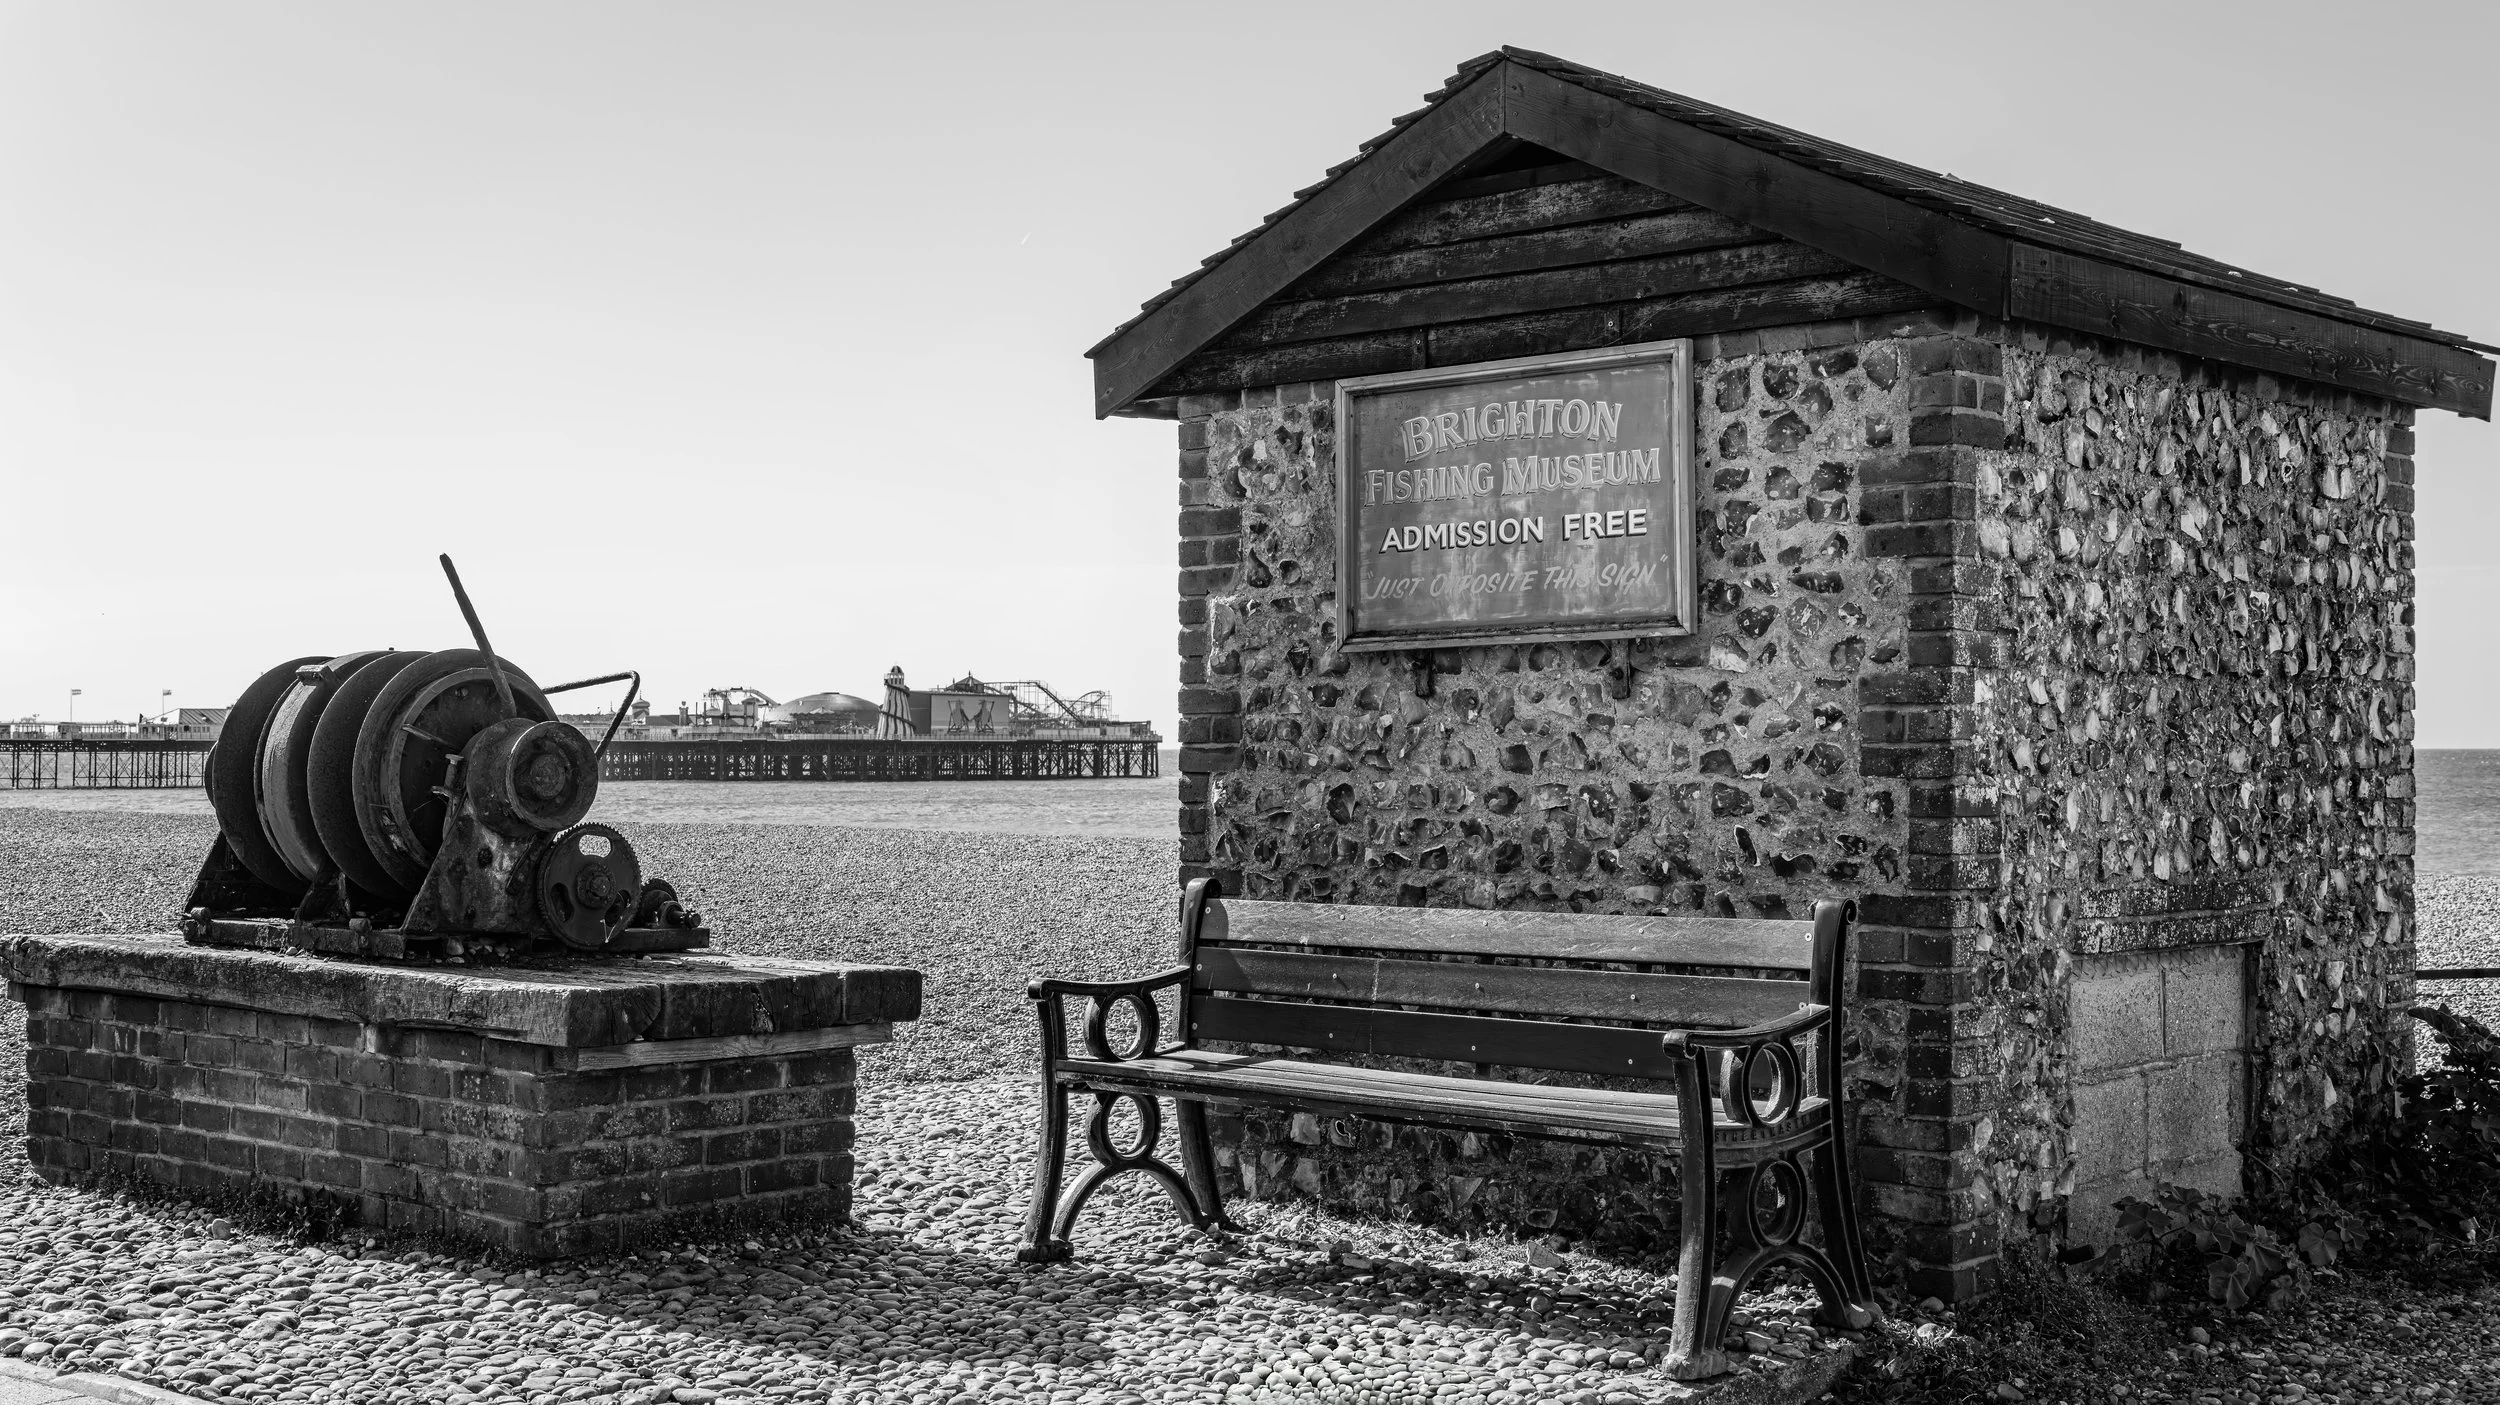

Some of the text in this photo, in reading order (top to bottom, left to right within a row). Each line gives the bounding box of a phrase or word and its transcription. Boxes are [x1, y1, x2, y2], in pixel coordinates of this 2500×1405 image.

[1402, 399, 1622, 464] BRIGHTON
[1364, 448, 1661, 507] FISHING MUSEUM
[1379, 509, 1648, 553] ADMISSION FREE
[1544, 563, 1590, 590] THIS
